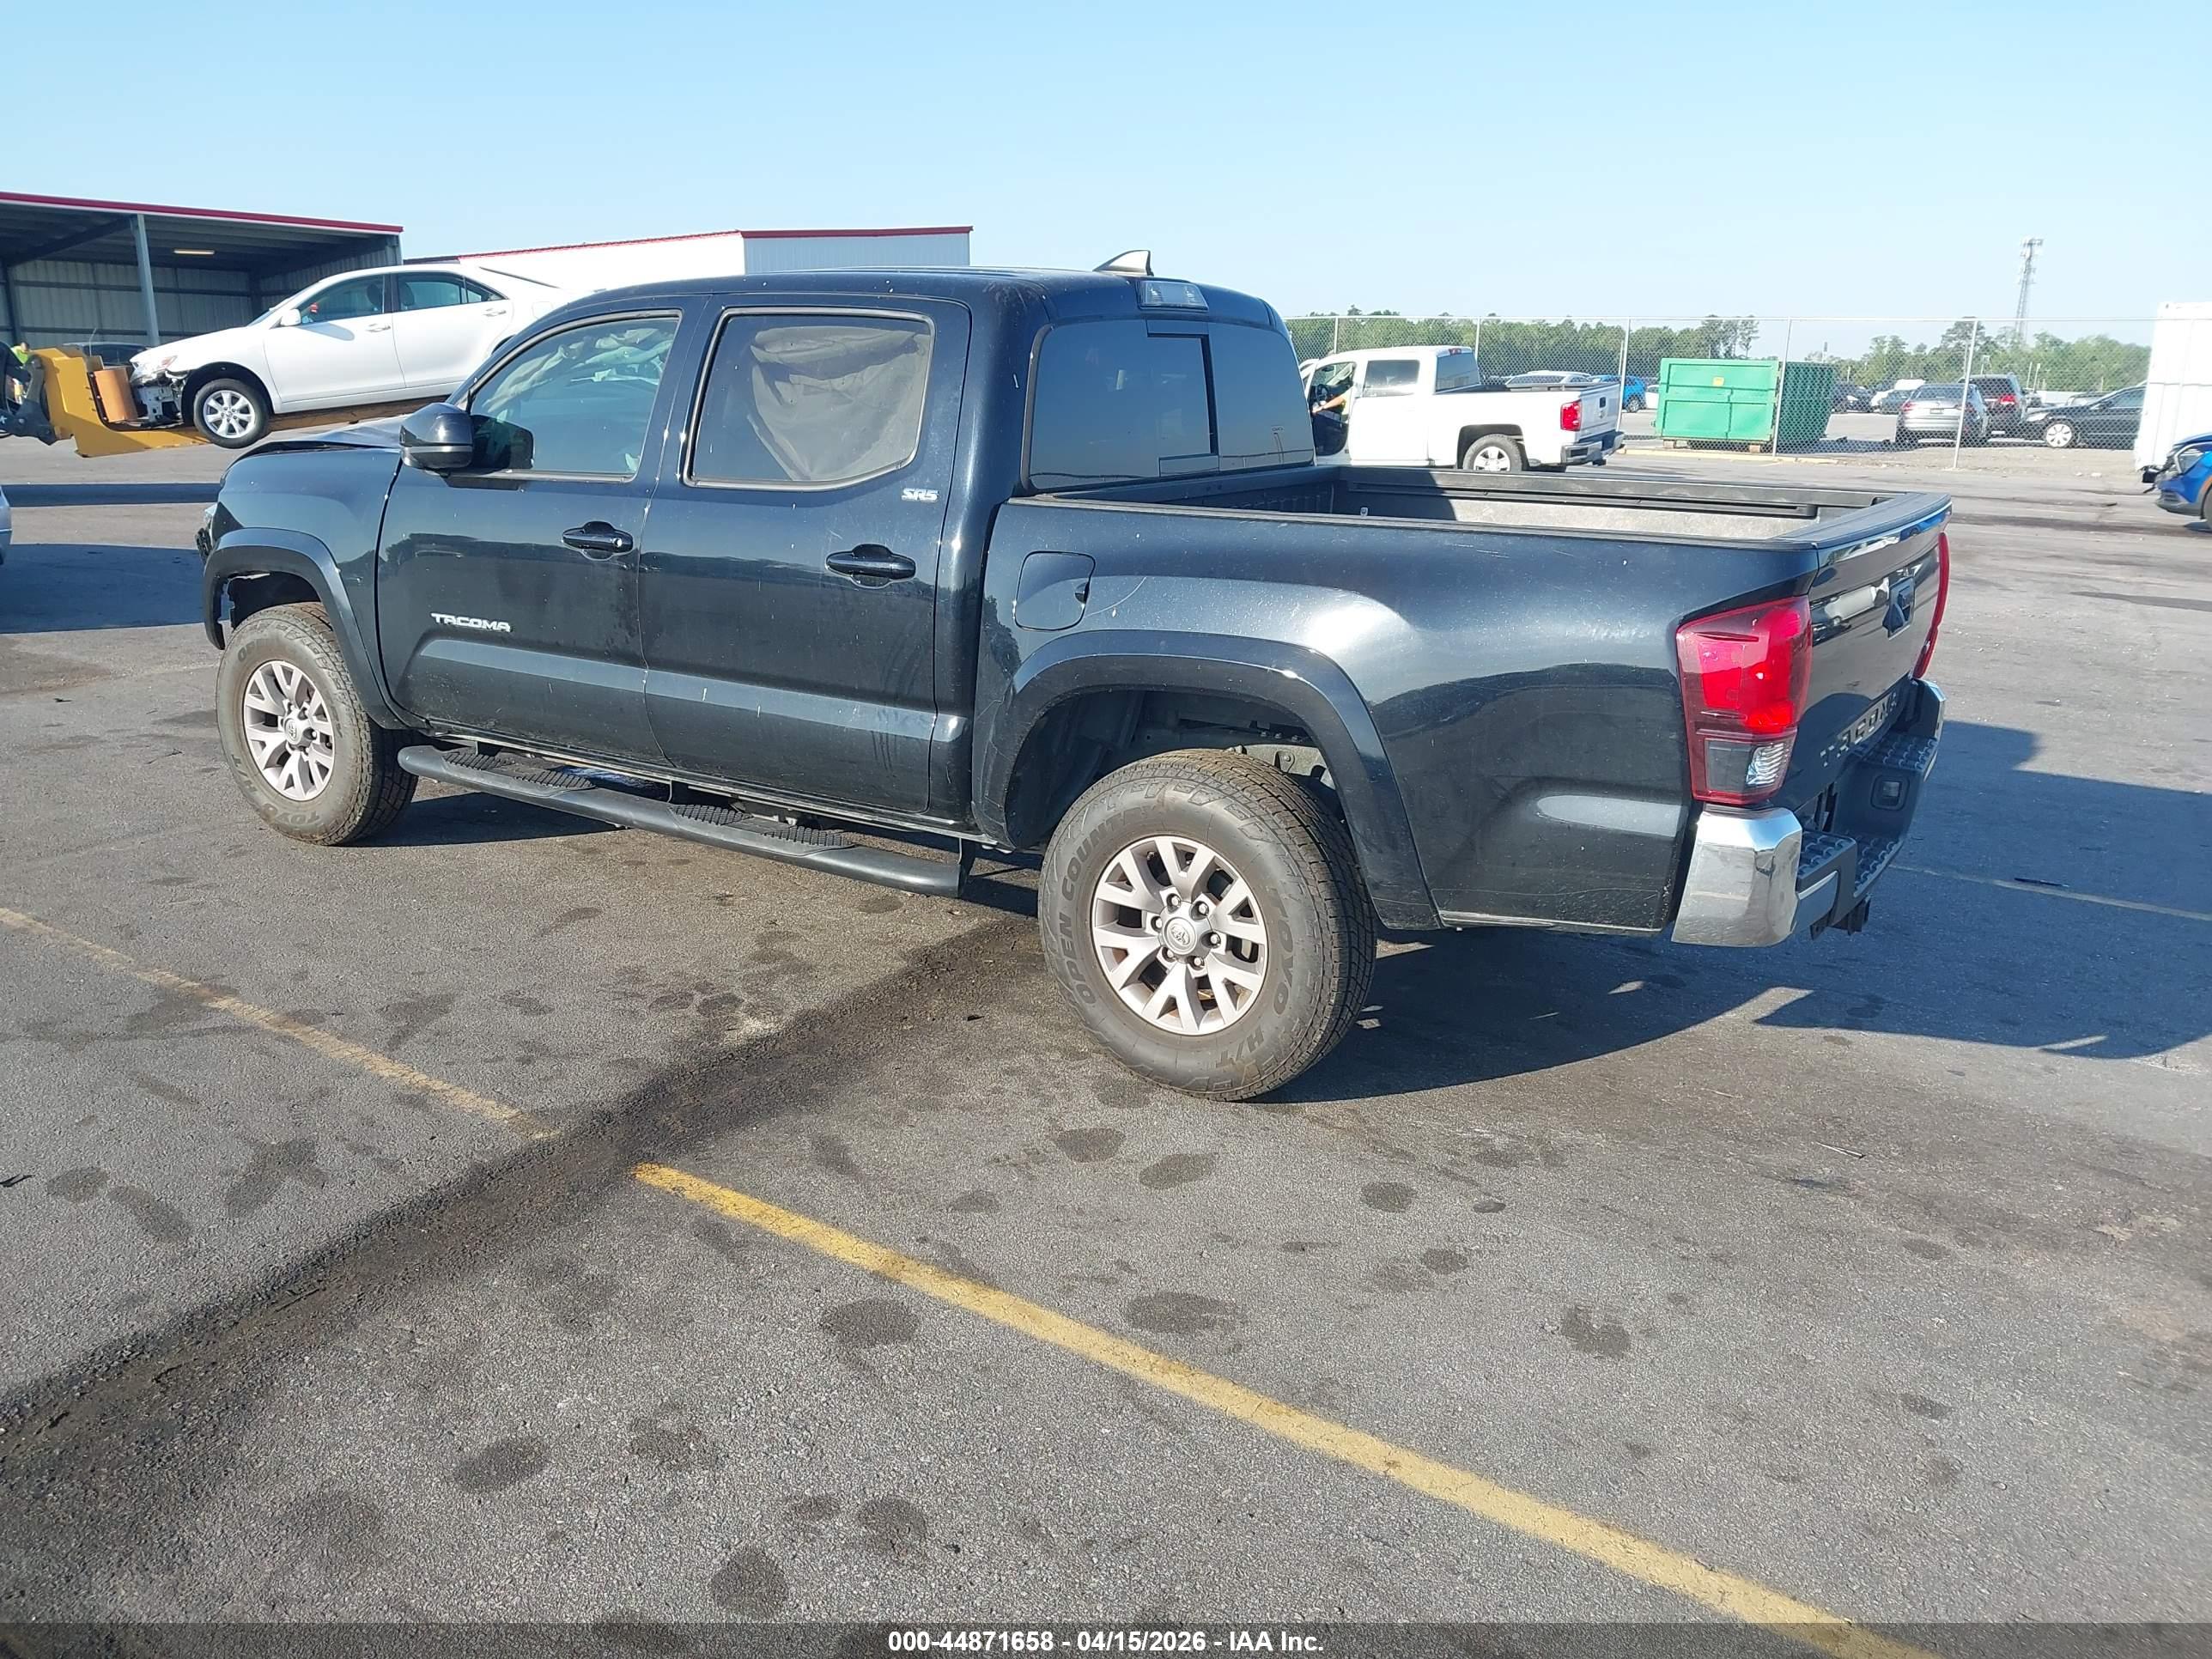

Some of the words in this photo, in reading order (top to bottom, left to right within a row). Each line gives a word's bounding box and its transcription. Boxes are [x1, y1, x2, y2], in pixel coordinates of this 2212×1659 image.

[901, 487, 939, 502] SR5
[430, 612, 511, 633] TACOMA
[1058, 911, 1097, 1005] OPEN
